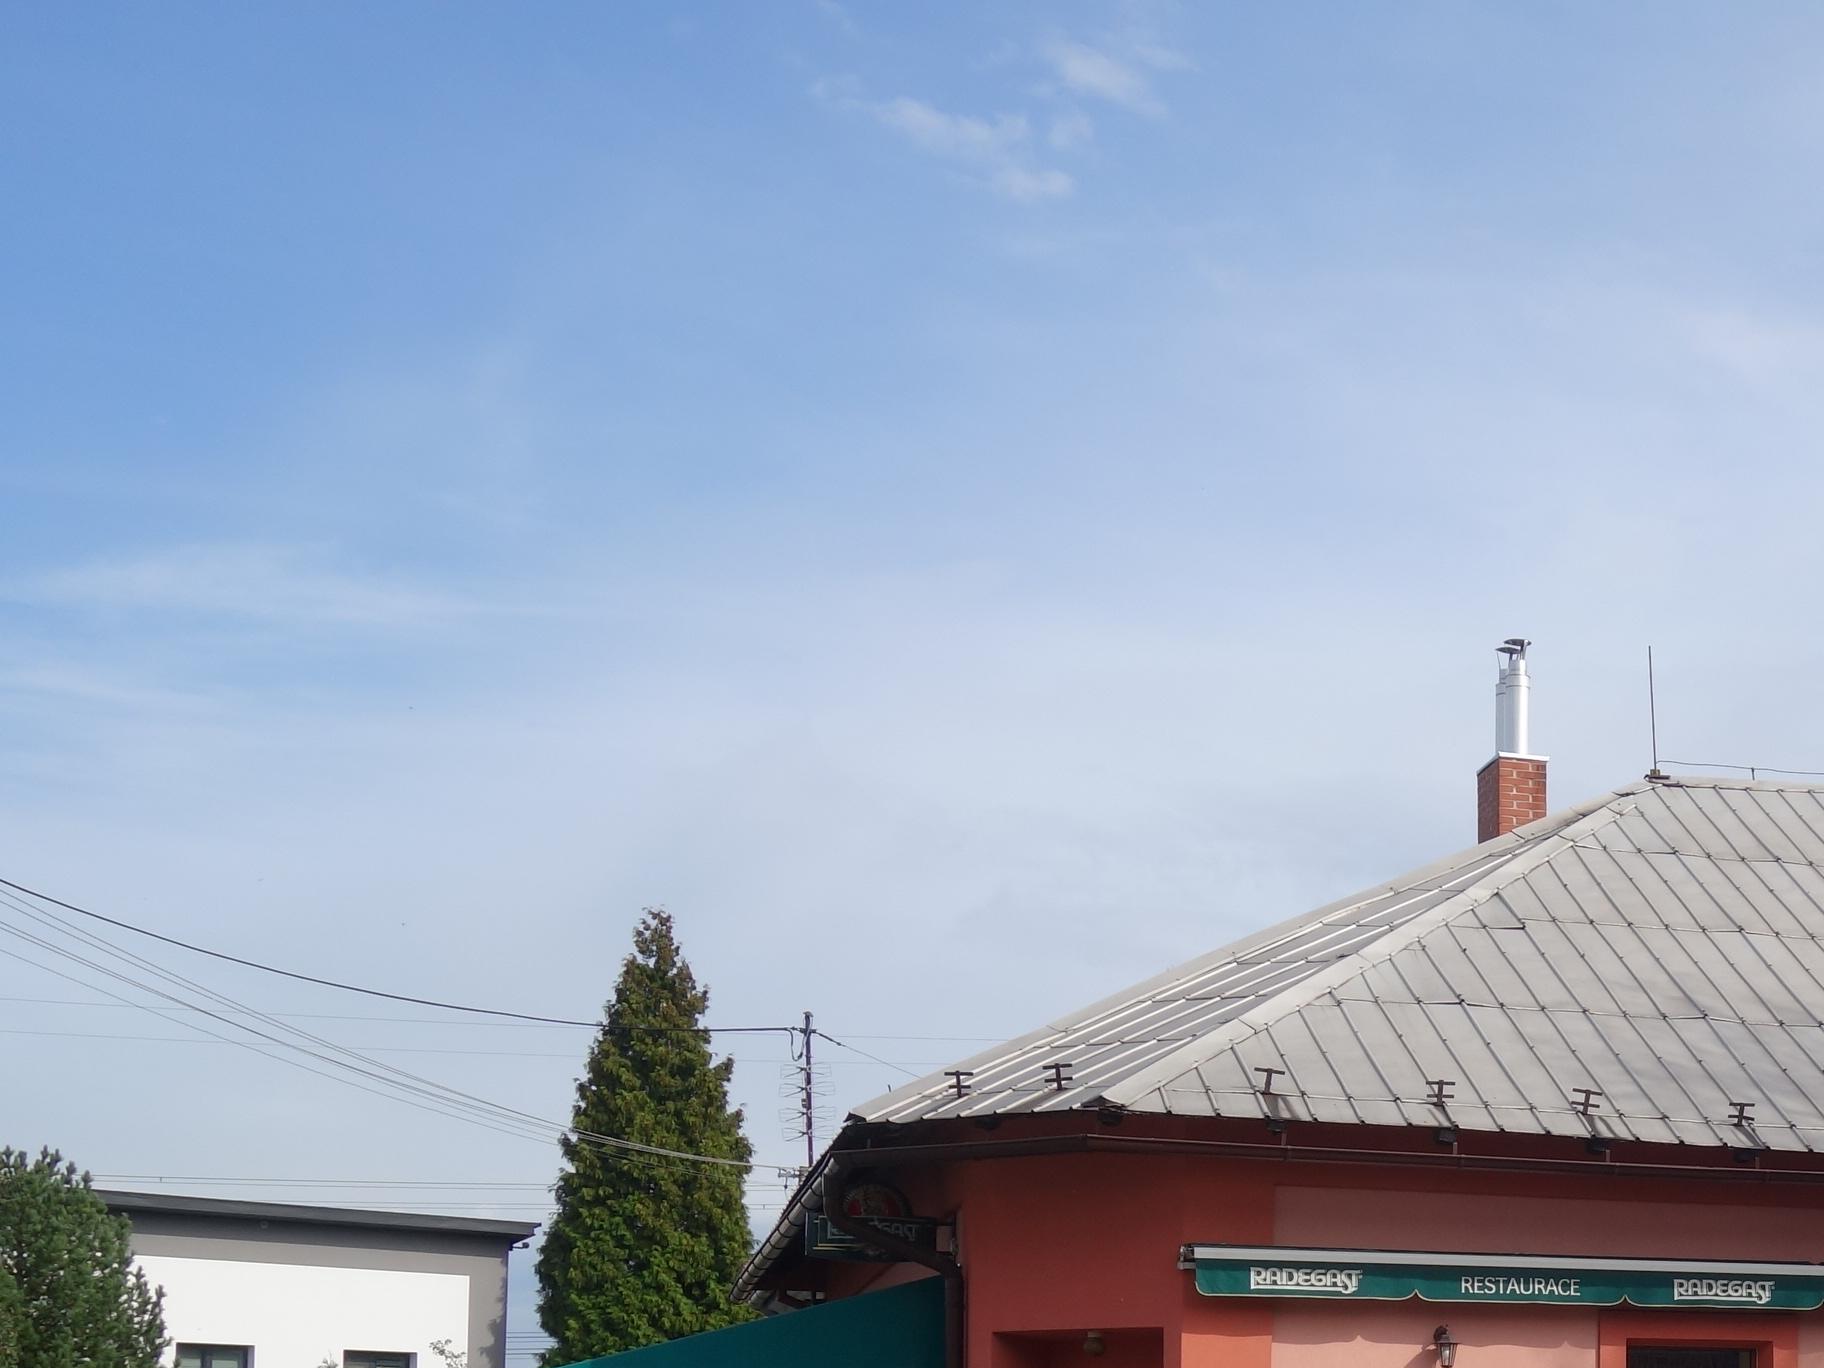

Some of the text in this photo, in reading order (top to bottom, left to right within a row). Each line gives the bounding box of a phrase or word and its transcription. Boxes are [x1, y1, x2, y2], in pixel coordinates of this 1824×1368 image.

[1250, 1267, 1362, 1294] RADEGAST
[1461, 1276, 1581, 1297] RESTAURACE
[1673, 1279, 1775, 1304] RADEGAST
